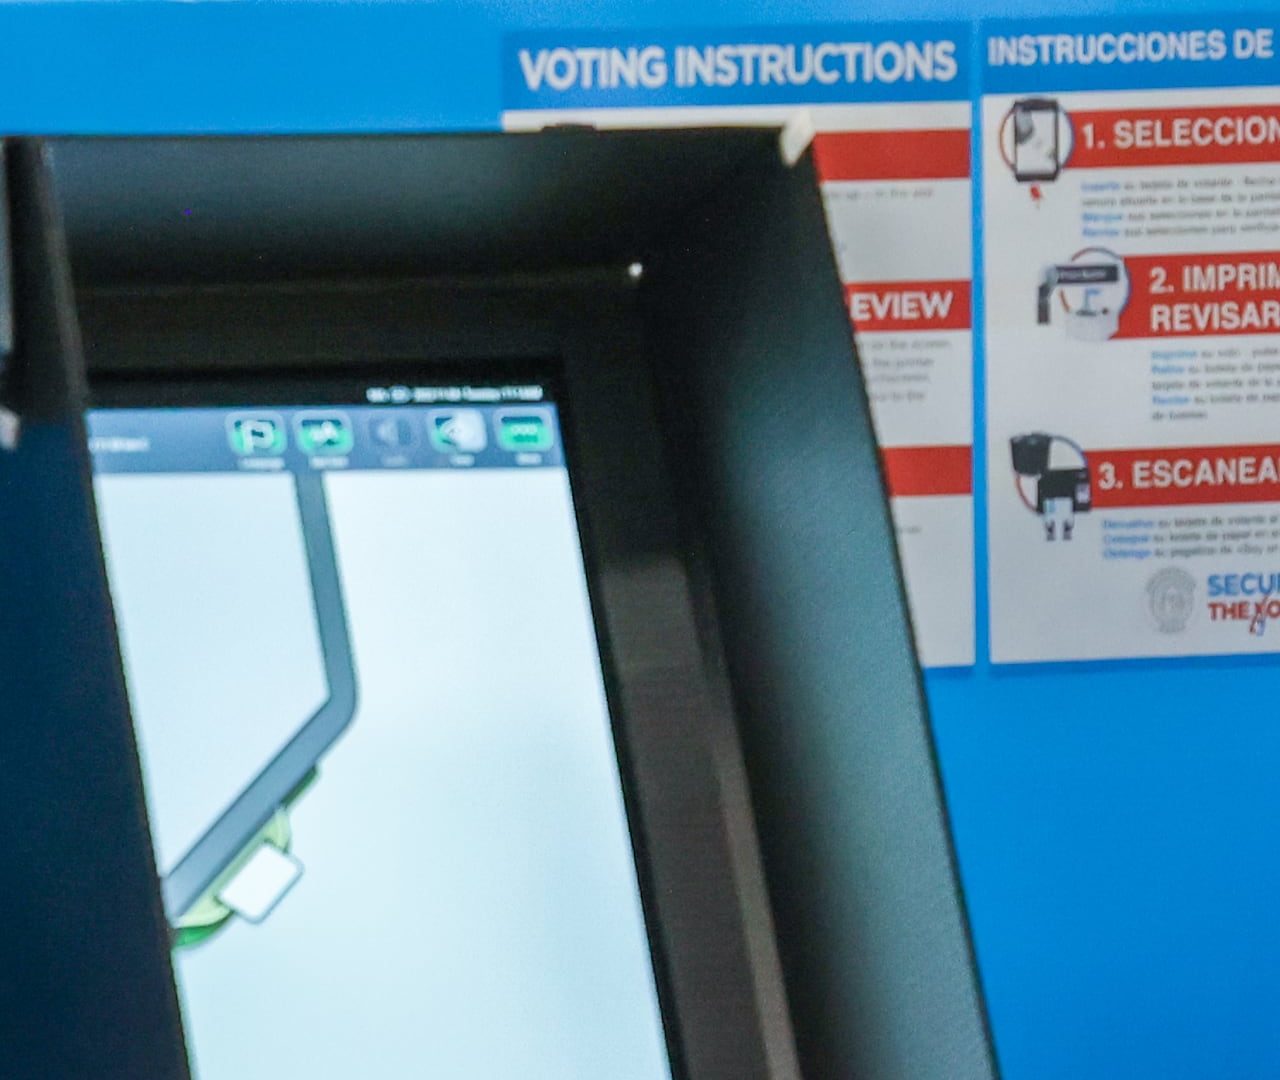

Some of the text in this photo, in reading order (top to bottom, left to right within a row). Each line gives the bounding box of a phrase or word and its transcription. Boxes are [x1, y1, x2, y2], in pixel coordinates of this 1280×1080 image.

[988, 27, 1274, 67] INSTRUCCIONES DE
[518, 40, 958, 91] VOTING INSTRUCTIONS
[1082, 122, 1106, 149] 1.
[1149, 266, 1175, 295] 2.
[1150, 299, 1280, 333] REVISAR
[1098, 455, 1280, 491] 3. ESCANEA
[1206, 600, 1249, 622] THE
